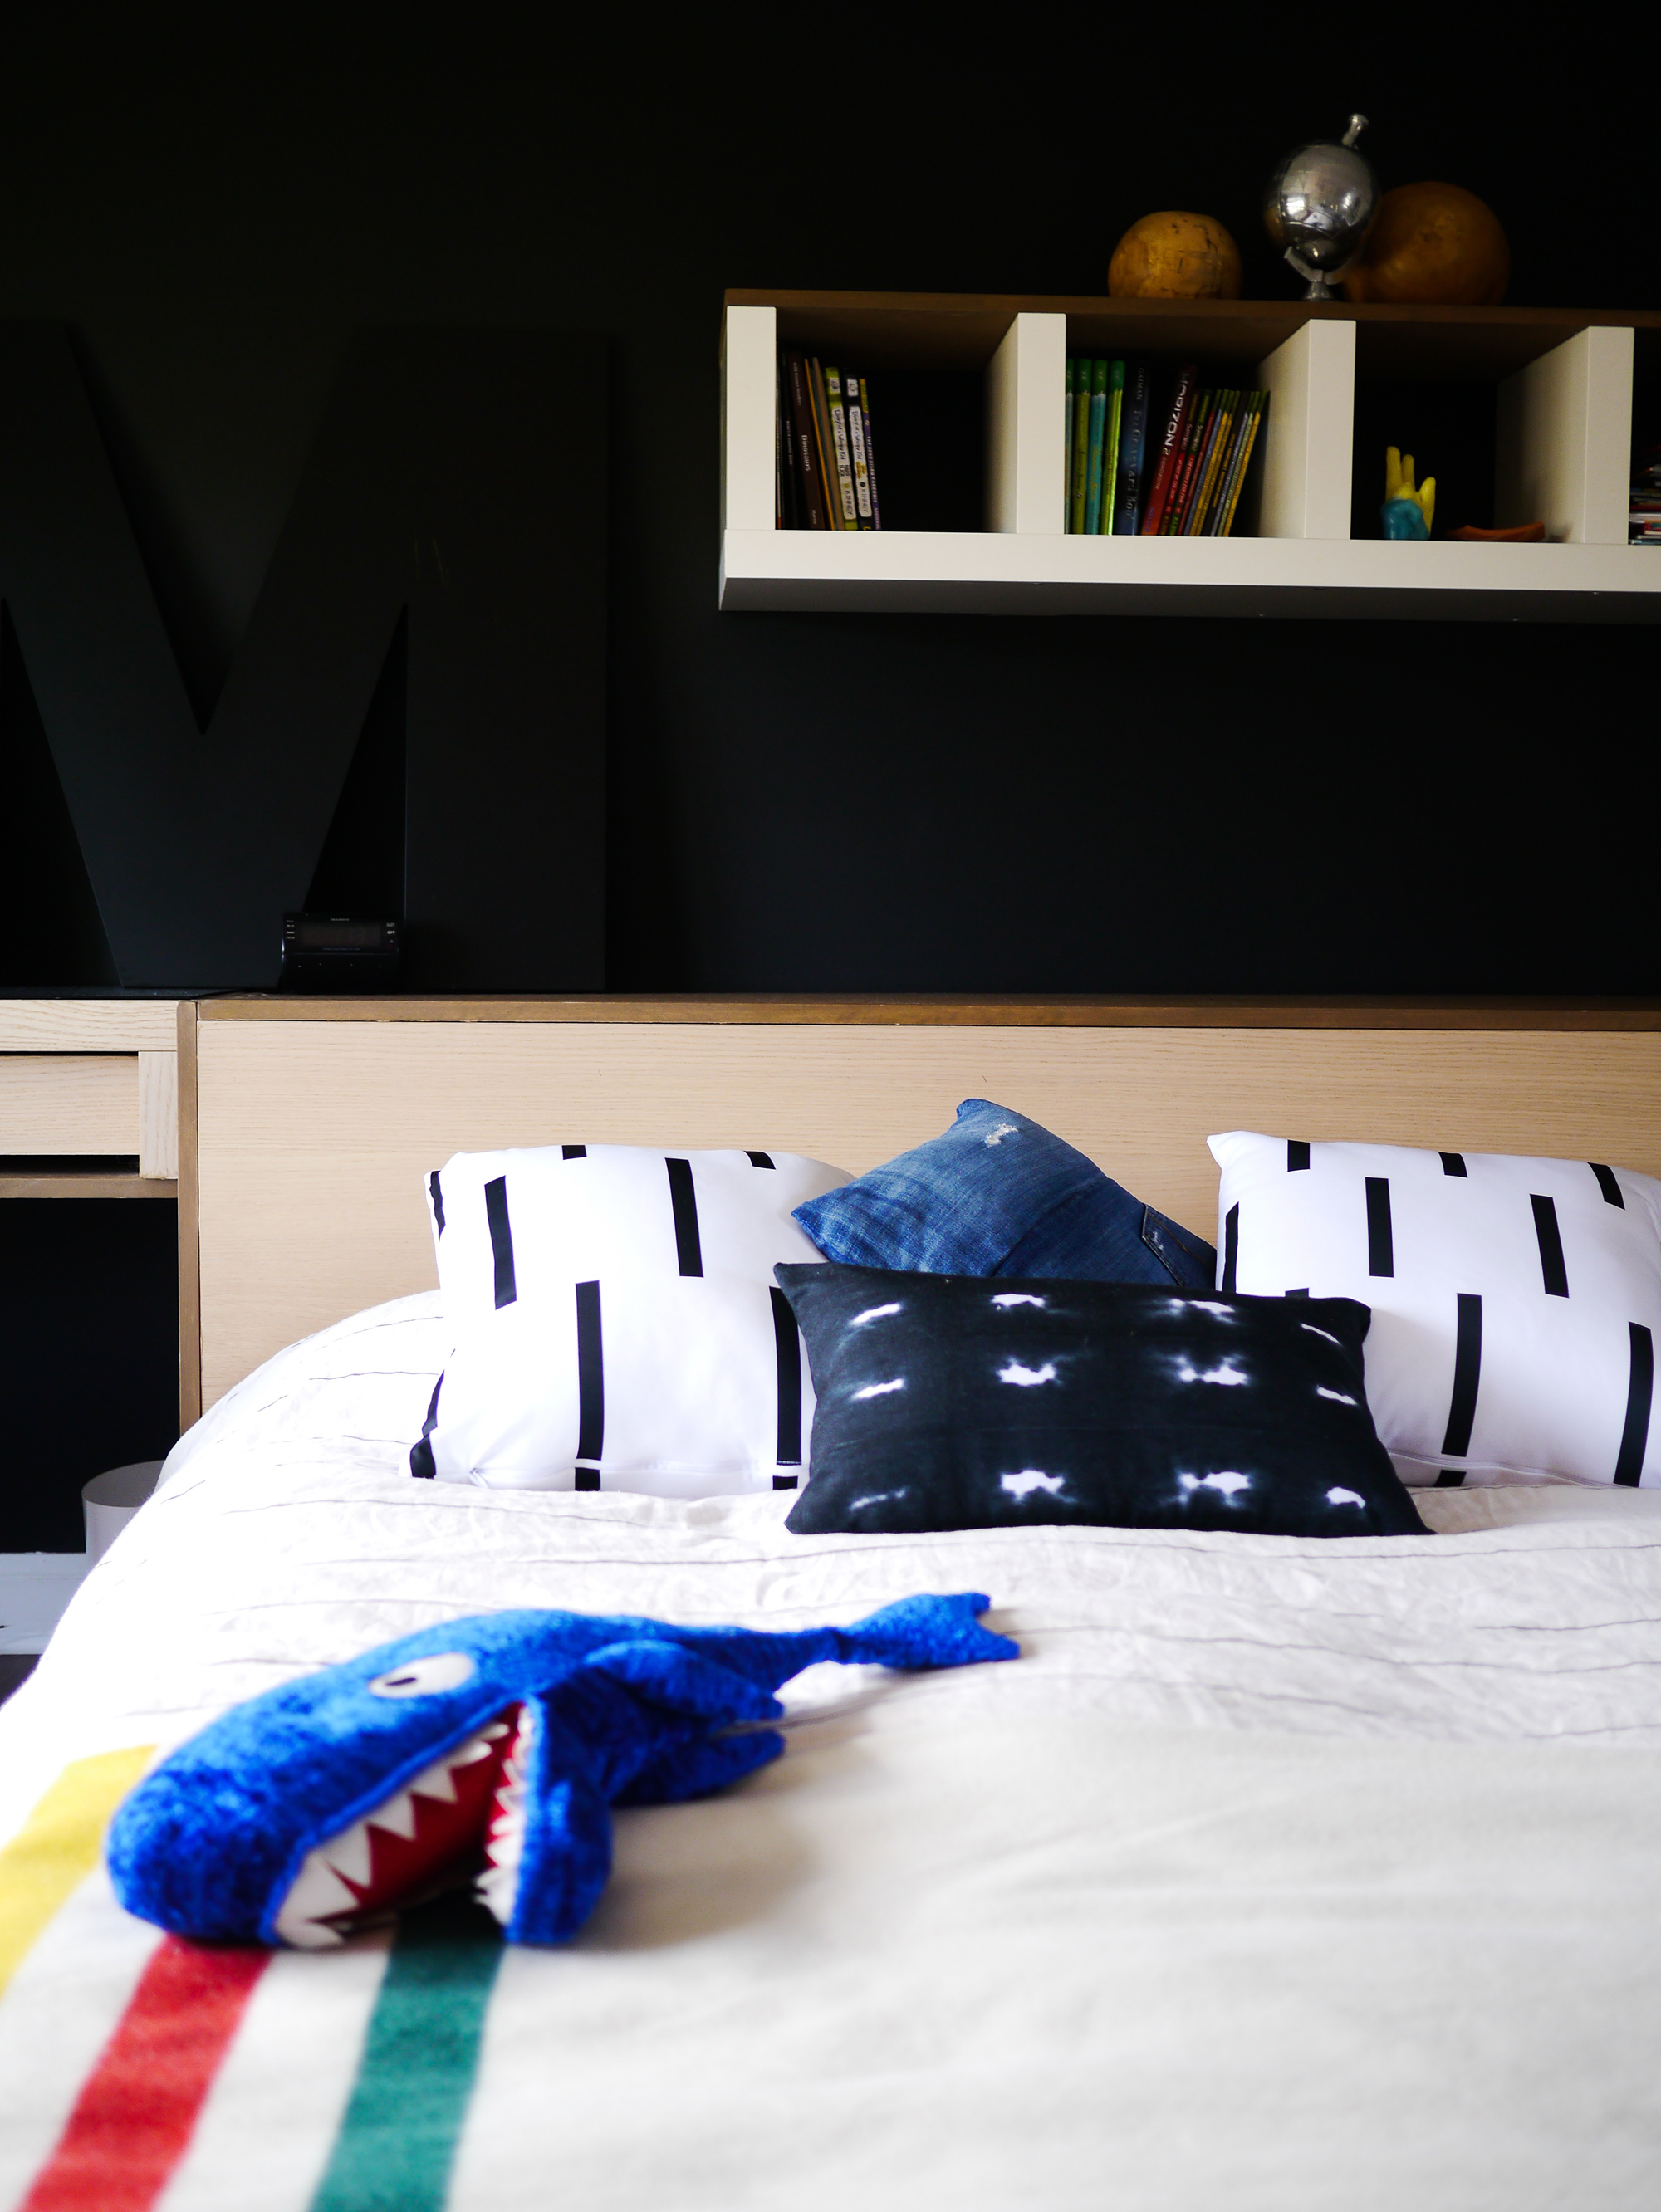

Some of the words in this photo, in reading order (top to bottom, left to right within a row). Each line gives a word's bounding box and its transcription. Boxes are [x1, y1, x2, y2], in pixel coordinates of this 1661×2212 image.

[1135, 367, 1144, 400] GAIMAN
[834, 409, 842, 425] Diary
[1164, 372, 1190, 446] HORIZON
[801, 434, 811, 471] Dinosaurs
[836, 434, 845, 450] Wimpy
[1162, 447, 1171, 455] 2
[845, 490, 853, 515] KINNEY
[860, 488, 869, 512] KINNEY
